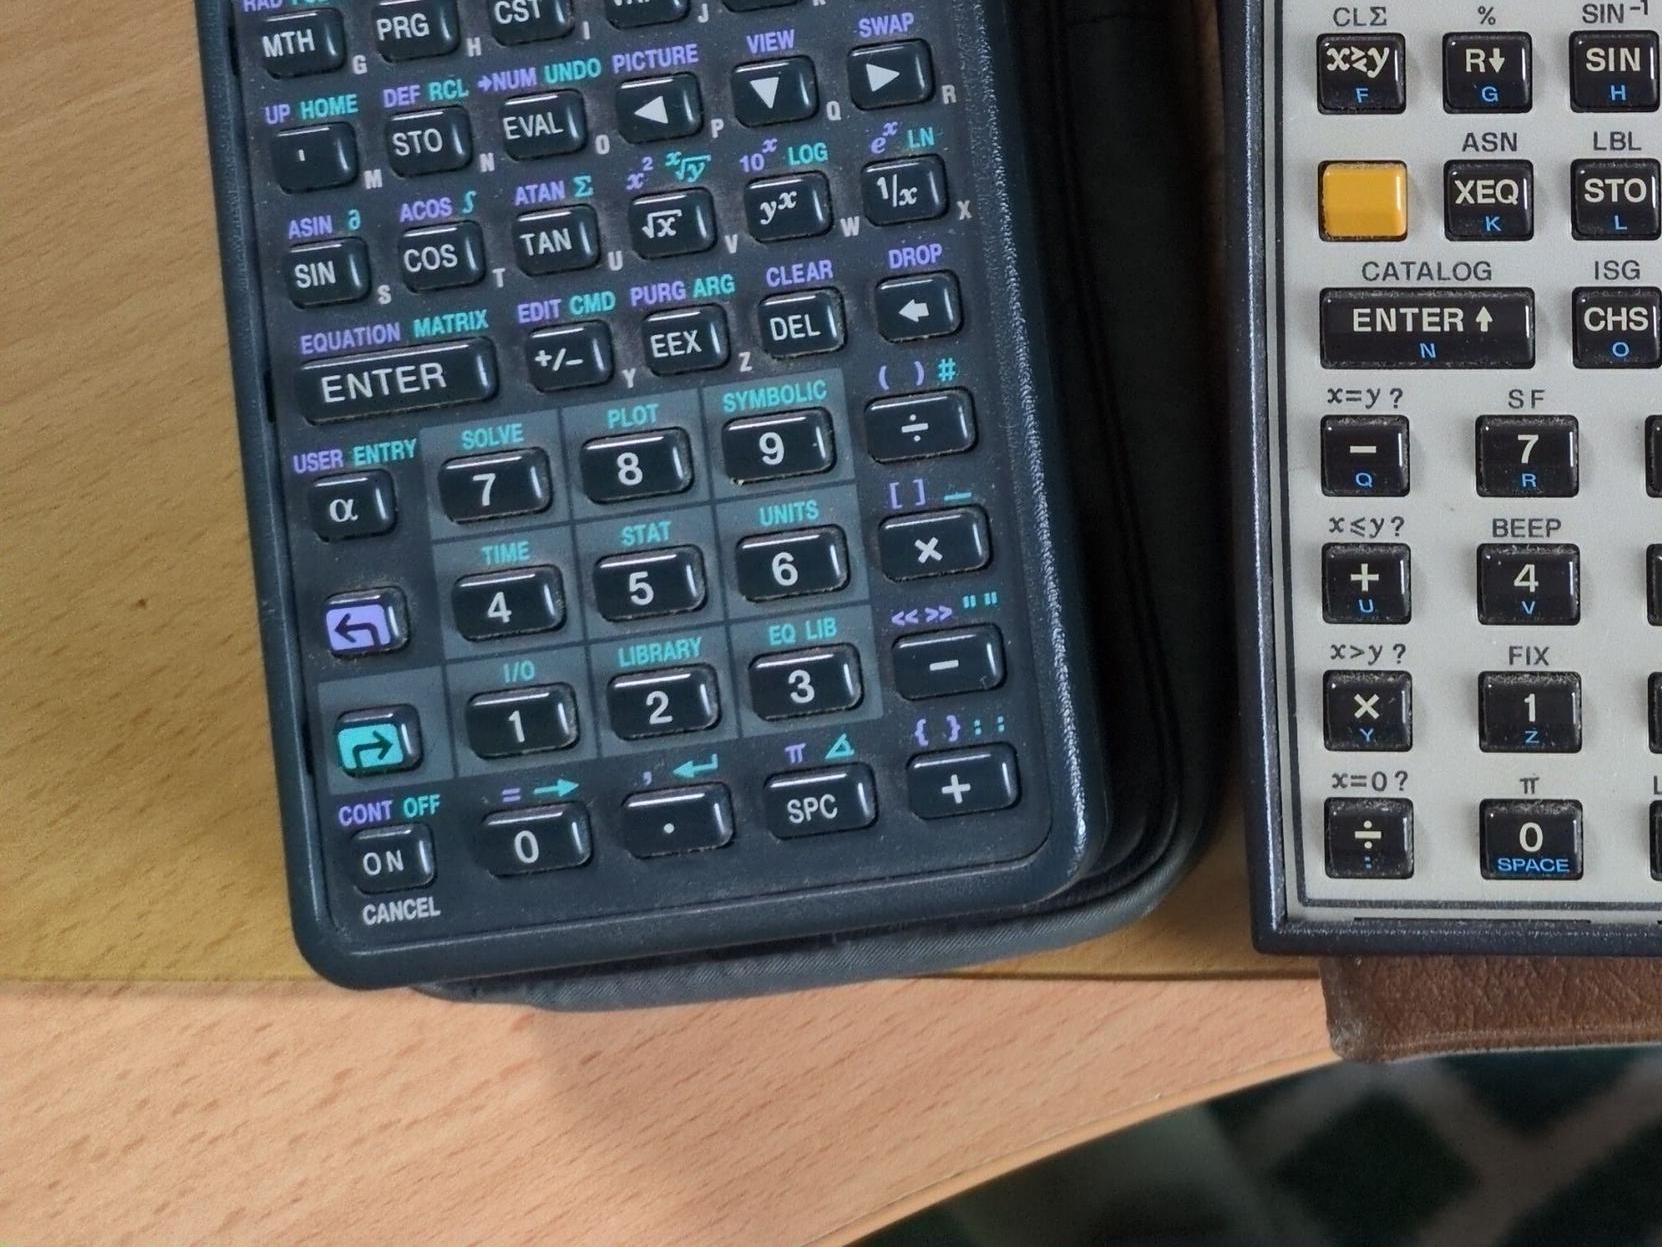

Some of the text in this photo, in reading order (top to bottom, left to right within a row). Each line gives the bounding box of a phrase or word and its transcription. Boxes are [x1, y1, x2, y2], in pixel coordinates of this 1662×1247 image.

[376, 13, 429, 41] PRG
[859, 12, 914, 37] SWAP
[263, 29, 314, 57] MTH
[747, 30, 795, 53] VIEW
[544, 58, 600, 84] UNDO
[612, 44, 698, 73] PICTURE
[1586, 48, 1640, 72] SIN
[383, 79, 469, 108] DEF RCL
[265, 94, 358, 125] UP HOME
[503, 112, 563, 139] EVAL
[908, 127, 934, 149] LN
[392, 129, 442, 156] STO
[788, 143, 828, 166] LOG
[1462, 133, 1517, 152] ASN
[1593, 131, 1641, 151] LBL
[515, 181, 564, 205] ATAN
[1455, 179, 1519, 205] XEQ
[1584, 179, 1646, 203] STO
[401, 197, 452, 222] ACOS
[288, 215, 332, 239] ASIN
[521, 229, 572, 255] TAN
[403, 245, 458, 272] COS
[889, 244, 942, 269] DROP
[1595, 260, 1641, 280] ISG
[295, 261, 336, 288] SIN
[766, 260, 833, 286] CLEAR
[1362, 261, 1492, 281] CATALOG
[630, 275, 734, 306] PURG ARG
[518, 291, 616, 323] EDIT CMD
[1353, 308, 1464, 332] ENTER
[1583, 306, 1649, 332] CHS
[301, 310, 488, 354] EQUATION MATRIX
[770, 315, 820, 340] DEL
[650, 330, 702, 358] EEX
[321, 362, 447, 403] ENTER
[723, 380, 827, 412] SYMBOLIC
[608, 404, 659, 427] PLOT
[461, 424, 523, 449] SOLVE
[759, 432, 784, 465] 9
[294, 439, 417, 474] USER ENTRY
[618, 452, 643, 485] 8
[472, 473, 496, 505] 7
[759, 500, 819, 526] UNITS
[621, 520, 672, 547] STAT
[1492, 519, 1562, 537] BEEP
[482, 541, 529, 565] TIME
[772, 553, 798, 585] 6
[629, 570, 655, 606] 5
[487, 592, 512, 623] 4
[768, 617, 837, 645] EQ LIB
[617, 636, 702, 668] LIBRARY
[1509, 646, 1549, 666] FIX
[503, 661, 534, 681] I/O
[788, 670, 815, 703] 3
[646, 691, 673, 725] 2
[508, 710, 525, 743] 1
[339, 794, 440, 826] CONT OFF
[787, 793, 838, 824] SPC
[514, 831, 539, 863] 0
[363, 850, 403, 875] ON
[1497, 858, 1570, 872] SPACE
[363, 897, 440, 925] CANCEL
